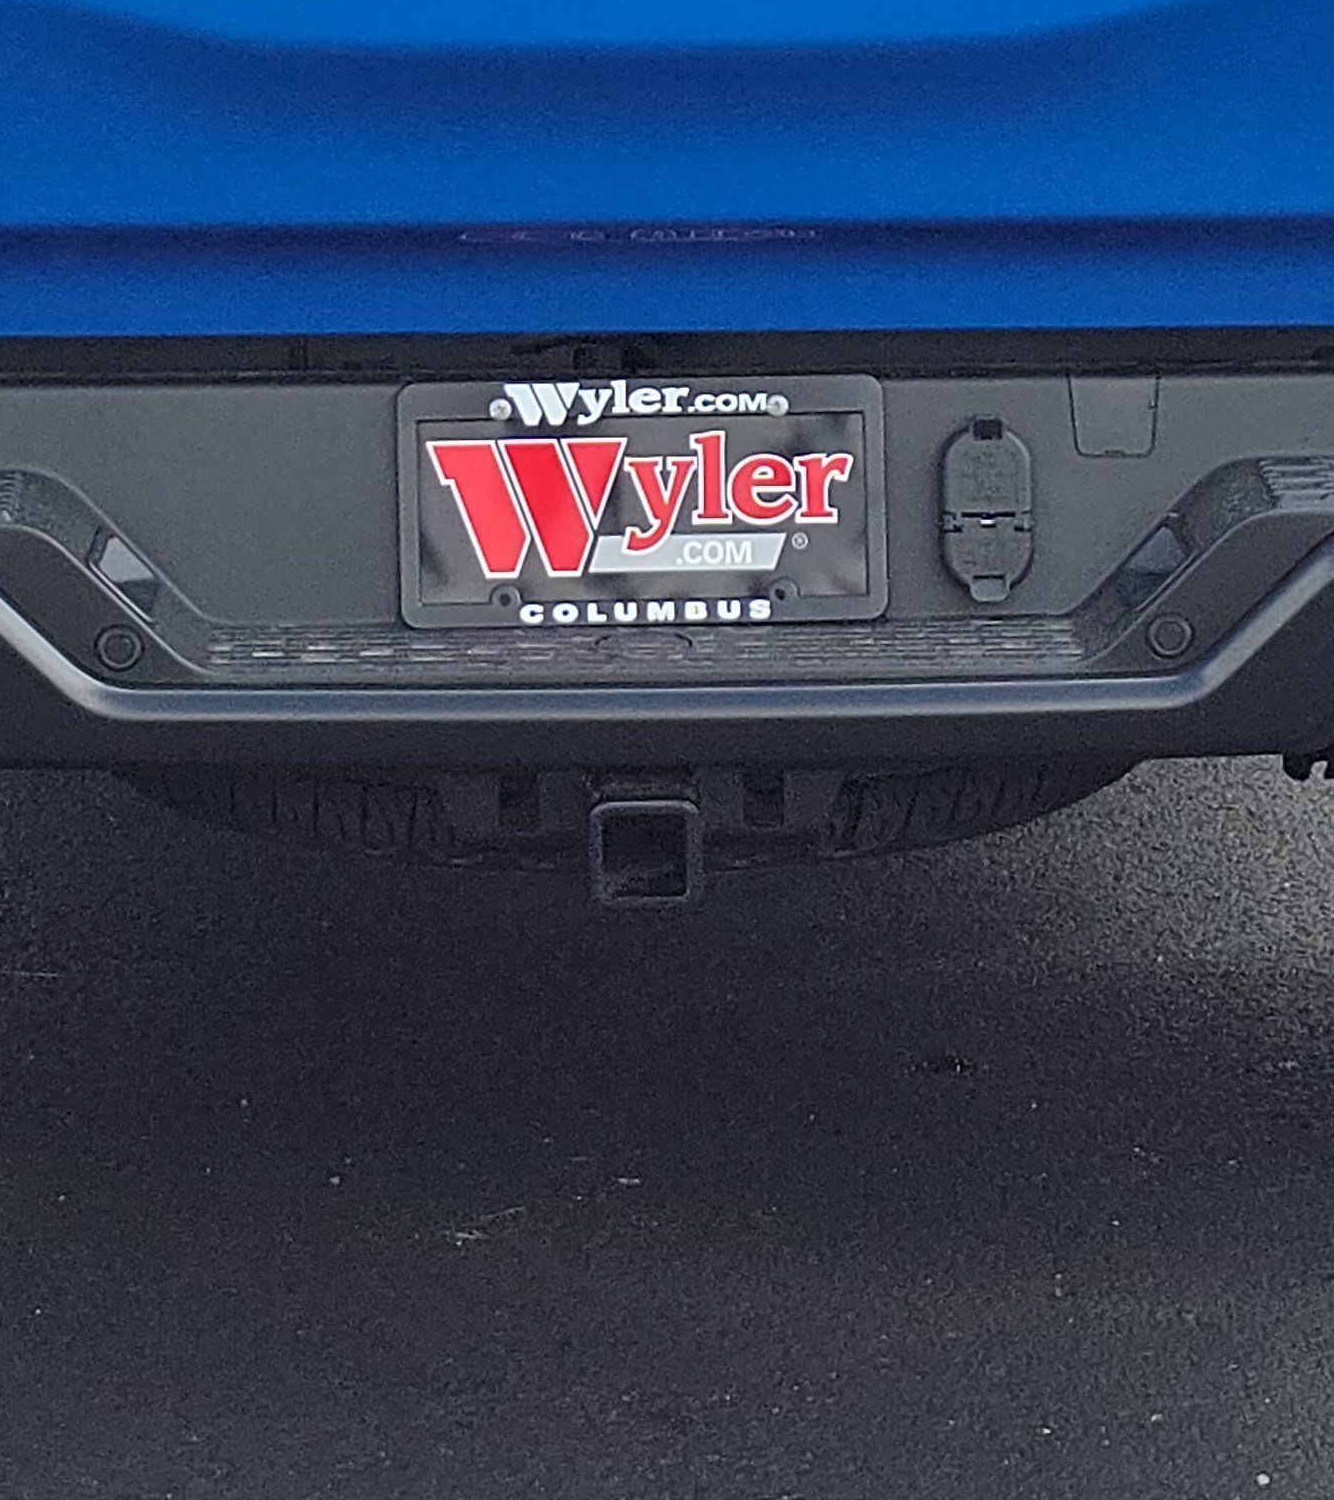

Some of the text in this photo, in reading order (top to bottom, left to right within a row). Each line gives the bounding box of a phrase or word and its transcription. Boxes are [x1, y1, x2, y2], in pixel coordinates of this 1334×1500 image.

[427, 431, 853, 578] Wyler
[675, 539, 753, 566] .COM
[520, 599, 772, 624] COLUMBUS
